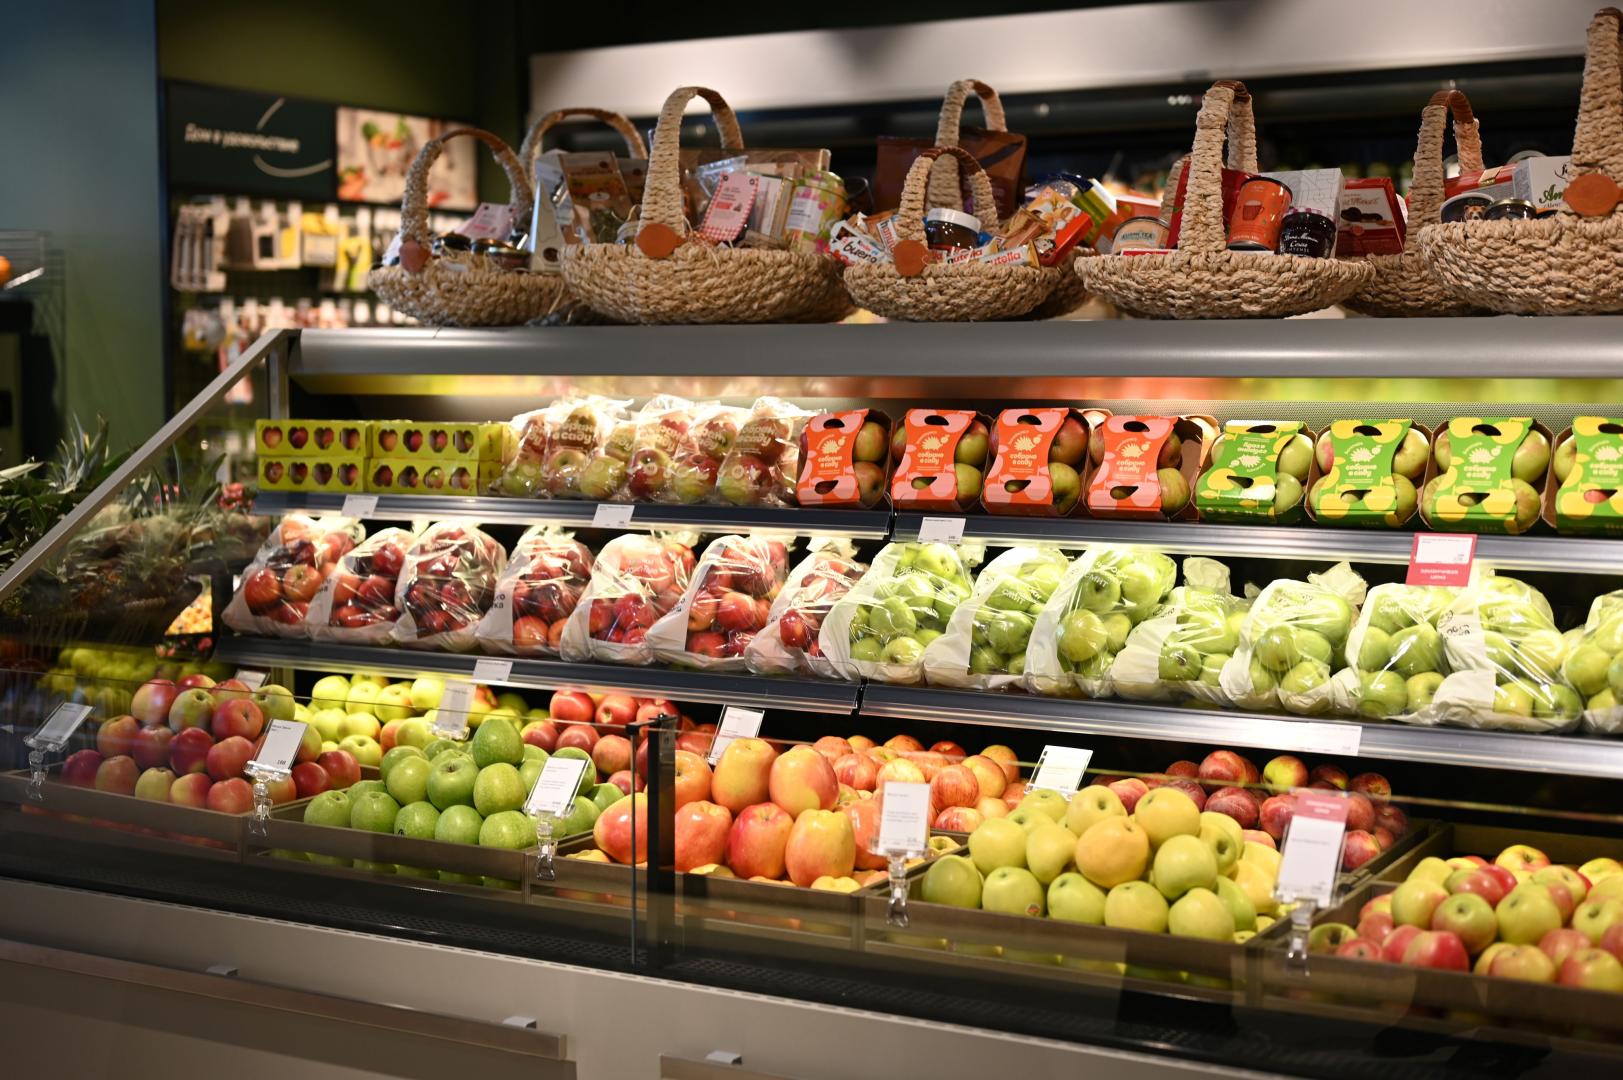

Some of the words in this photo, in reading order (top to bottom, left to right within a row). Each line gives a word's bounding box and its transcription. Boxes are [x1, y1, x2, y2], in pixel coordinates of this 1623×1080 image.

[843, 241, 877, 264] bueno
[984, 251, 1021, 266] utella
[561, 431, 592, 445] саду
[1010, 451, 1037, 459] собрано
